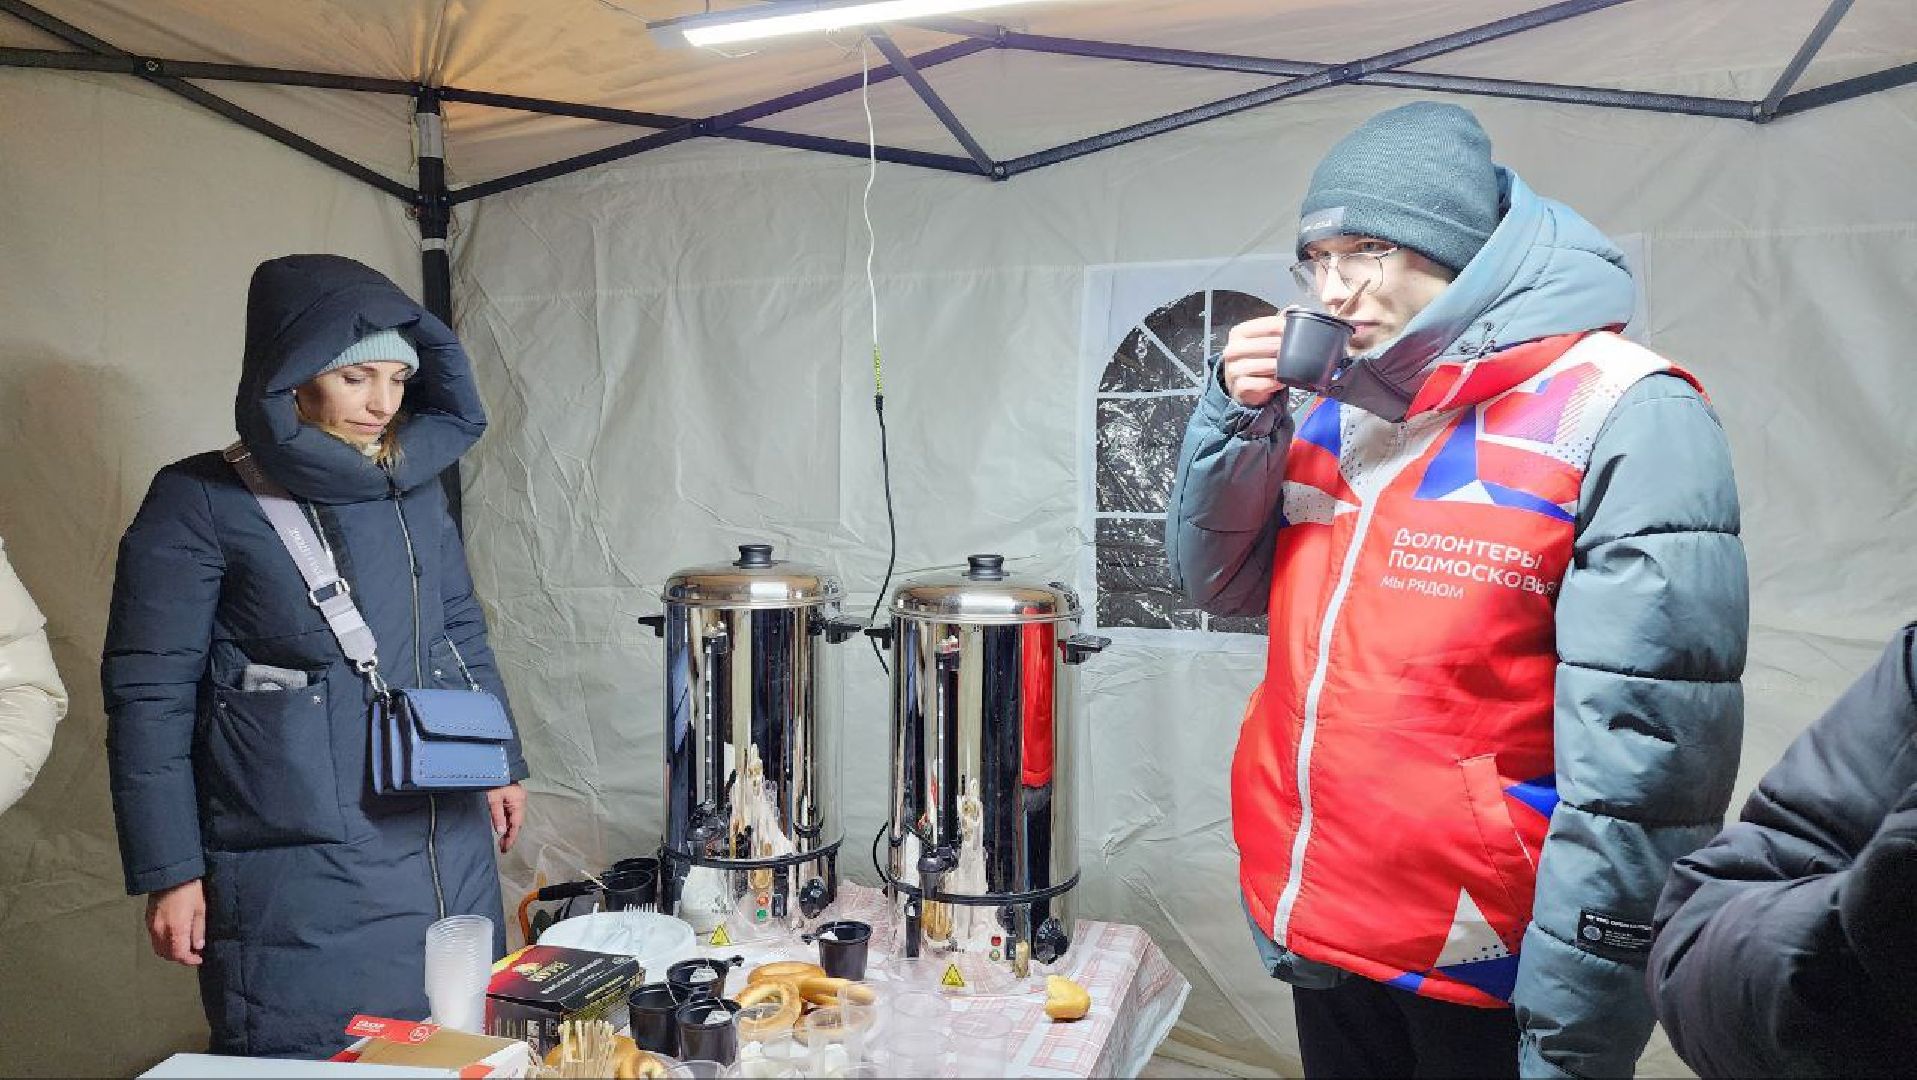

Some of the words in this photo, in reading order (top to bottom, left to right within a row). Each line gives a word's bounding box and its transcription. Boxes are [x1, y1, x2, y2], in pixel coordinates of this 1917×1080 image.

[1393, 527, 1543, 570] ВОЛОНТЕРЫ
[1381, 575, 1404, 590] МЫ
[1406, 578, 1464, 599] РЯДОМ
